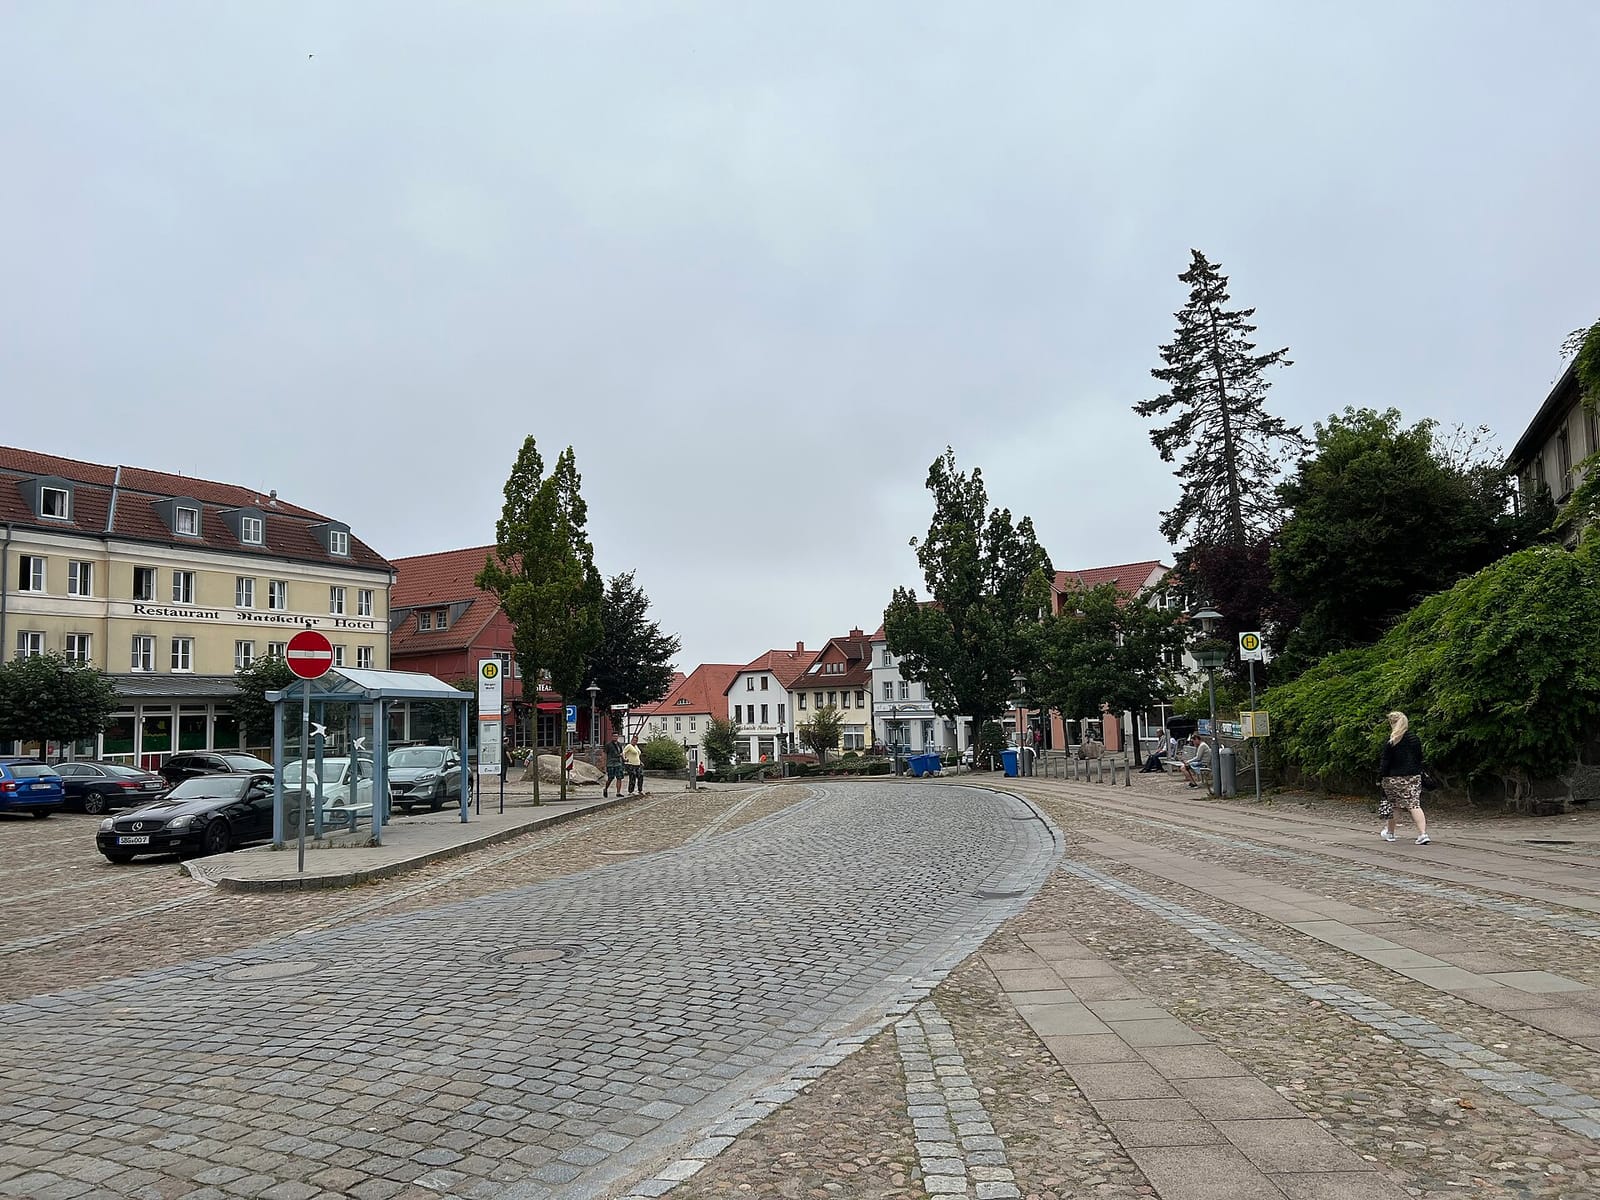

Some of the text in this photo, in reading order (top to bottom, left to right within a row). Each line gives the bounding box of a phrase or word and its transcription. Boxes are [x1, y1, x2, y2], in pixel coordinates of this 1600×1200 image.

[133, 603, 220, 619] Restaurant
[334, 618, 375, 629] Hotel
[1246, 637, 1254, 647] H
[486, 666, 494, 676] H
[566, 707, 574, 721] P
